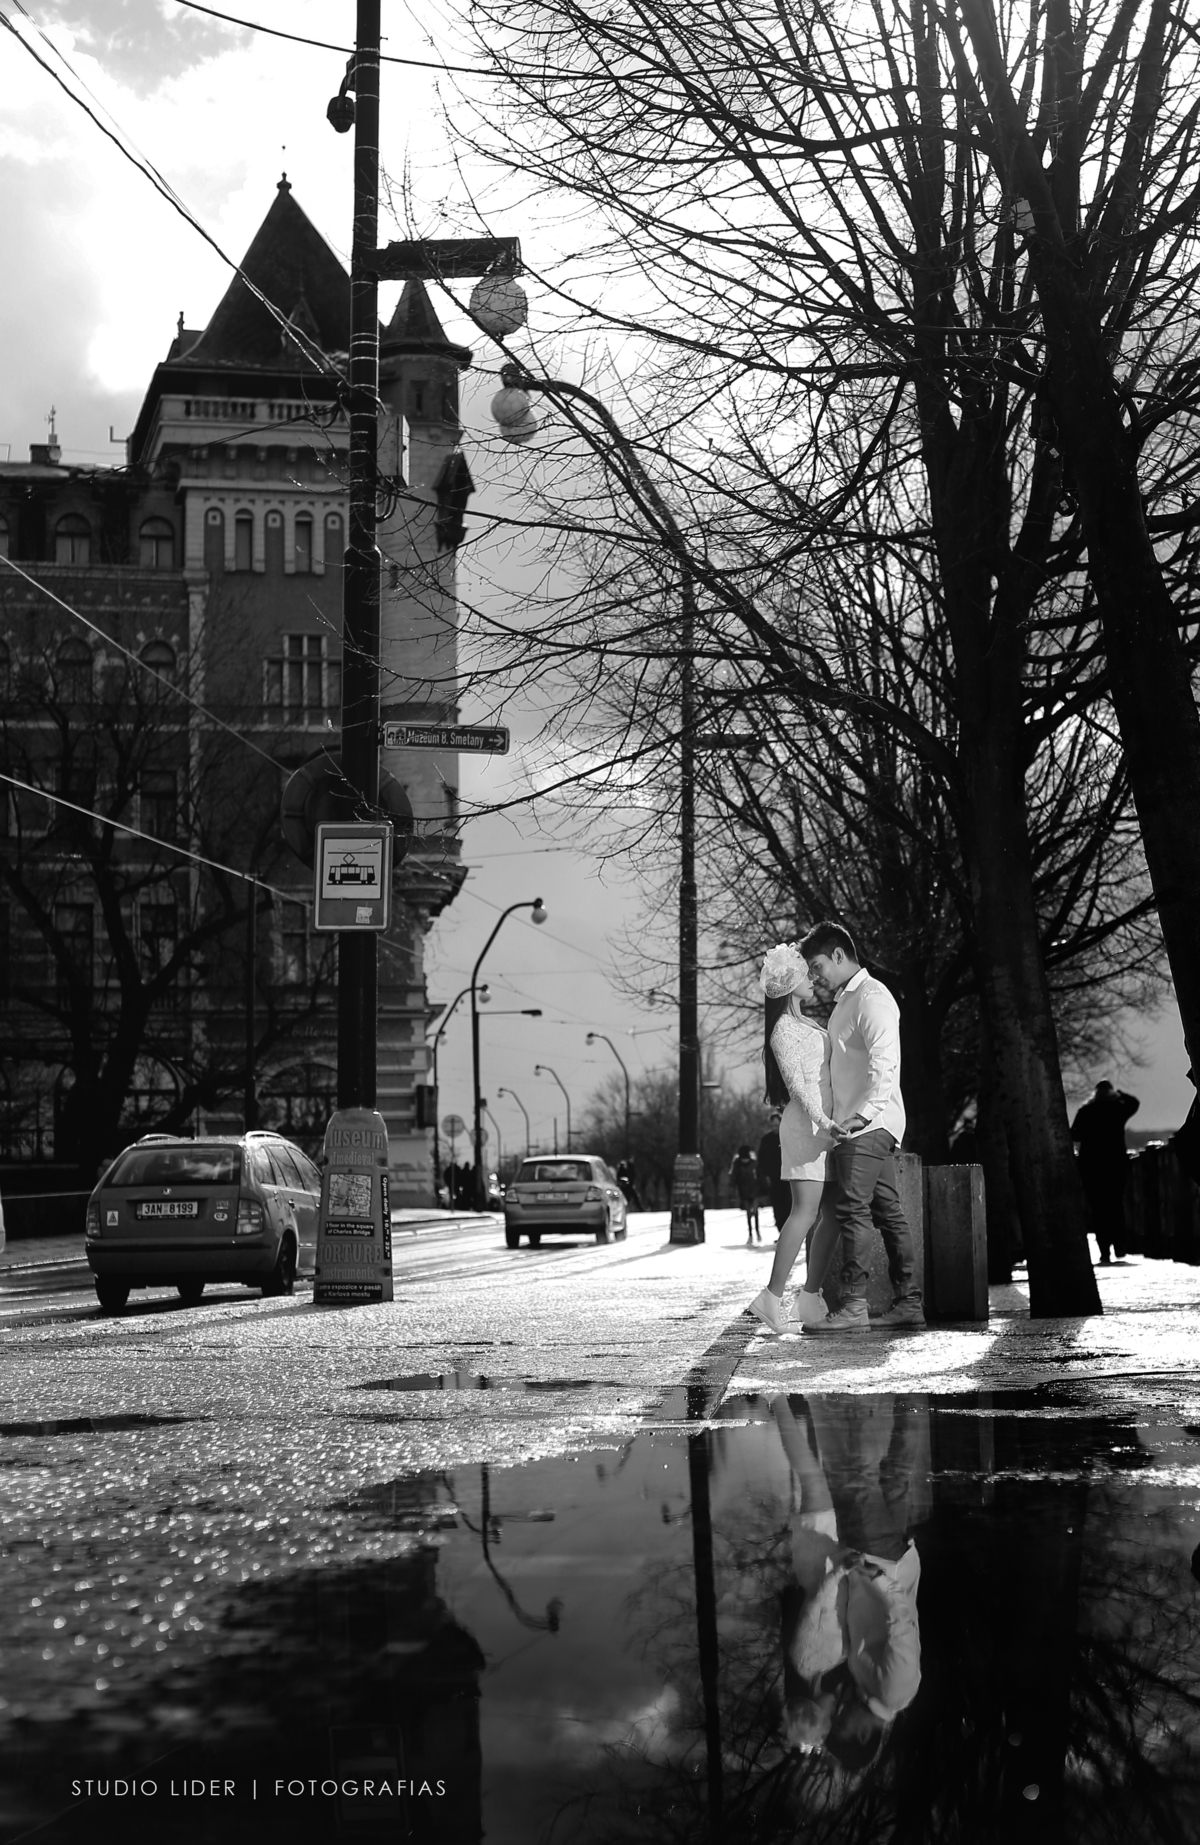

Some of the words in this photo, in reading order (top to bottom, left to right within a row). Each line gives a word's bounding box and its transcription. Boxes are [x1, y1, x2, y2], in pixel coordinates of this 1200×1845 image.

[450, 732, 484, 749] Smetany
[336, 1151, 375, 1165] medieval
[144, 1203, 163, 1215] 3AN
[169, 1203, 194, 1214] 8199
[352, 1229, 371, 1237] Bridge
[319, 1243, 382, 1264] TORTURE
[322, 1265, 375, 1280] instruments
